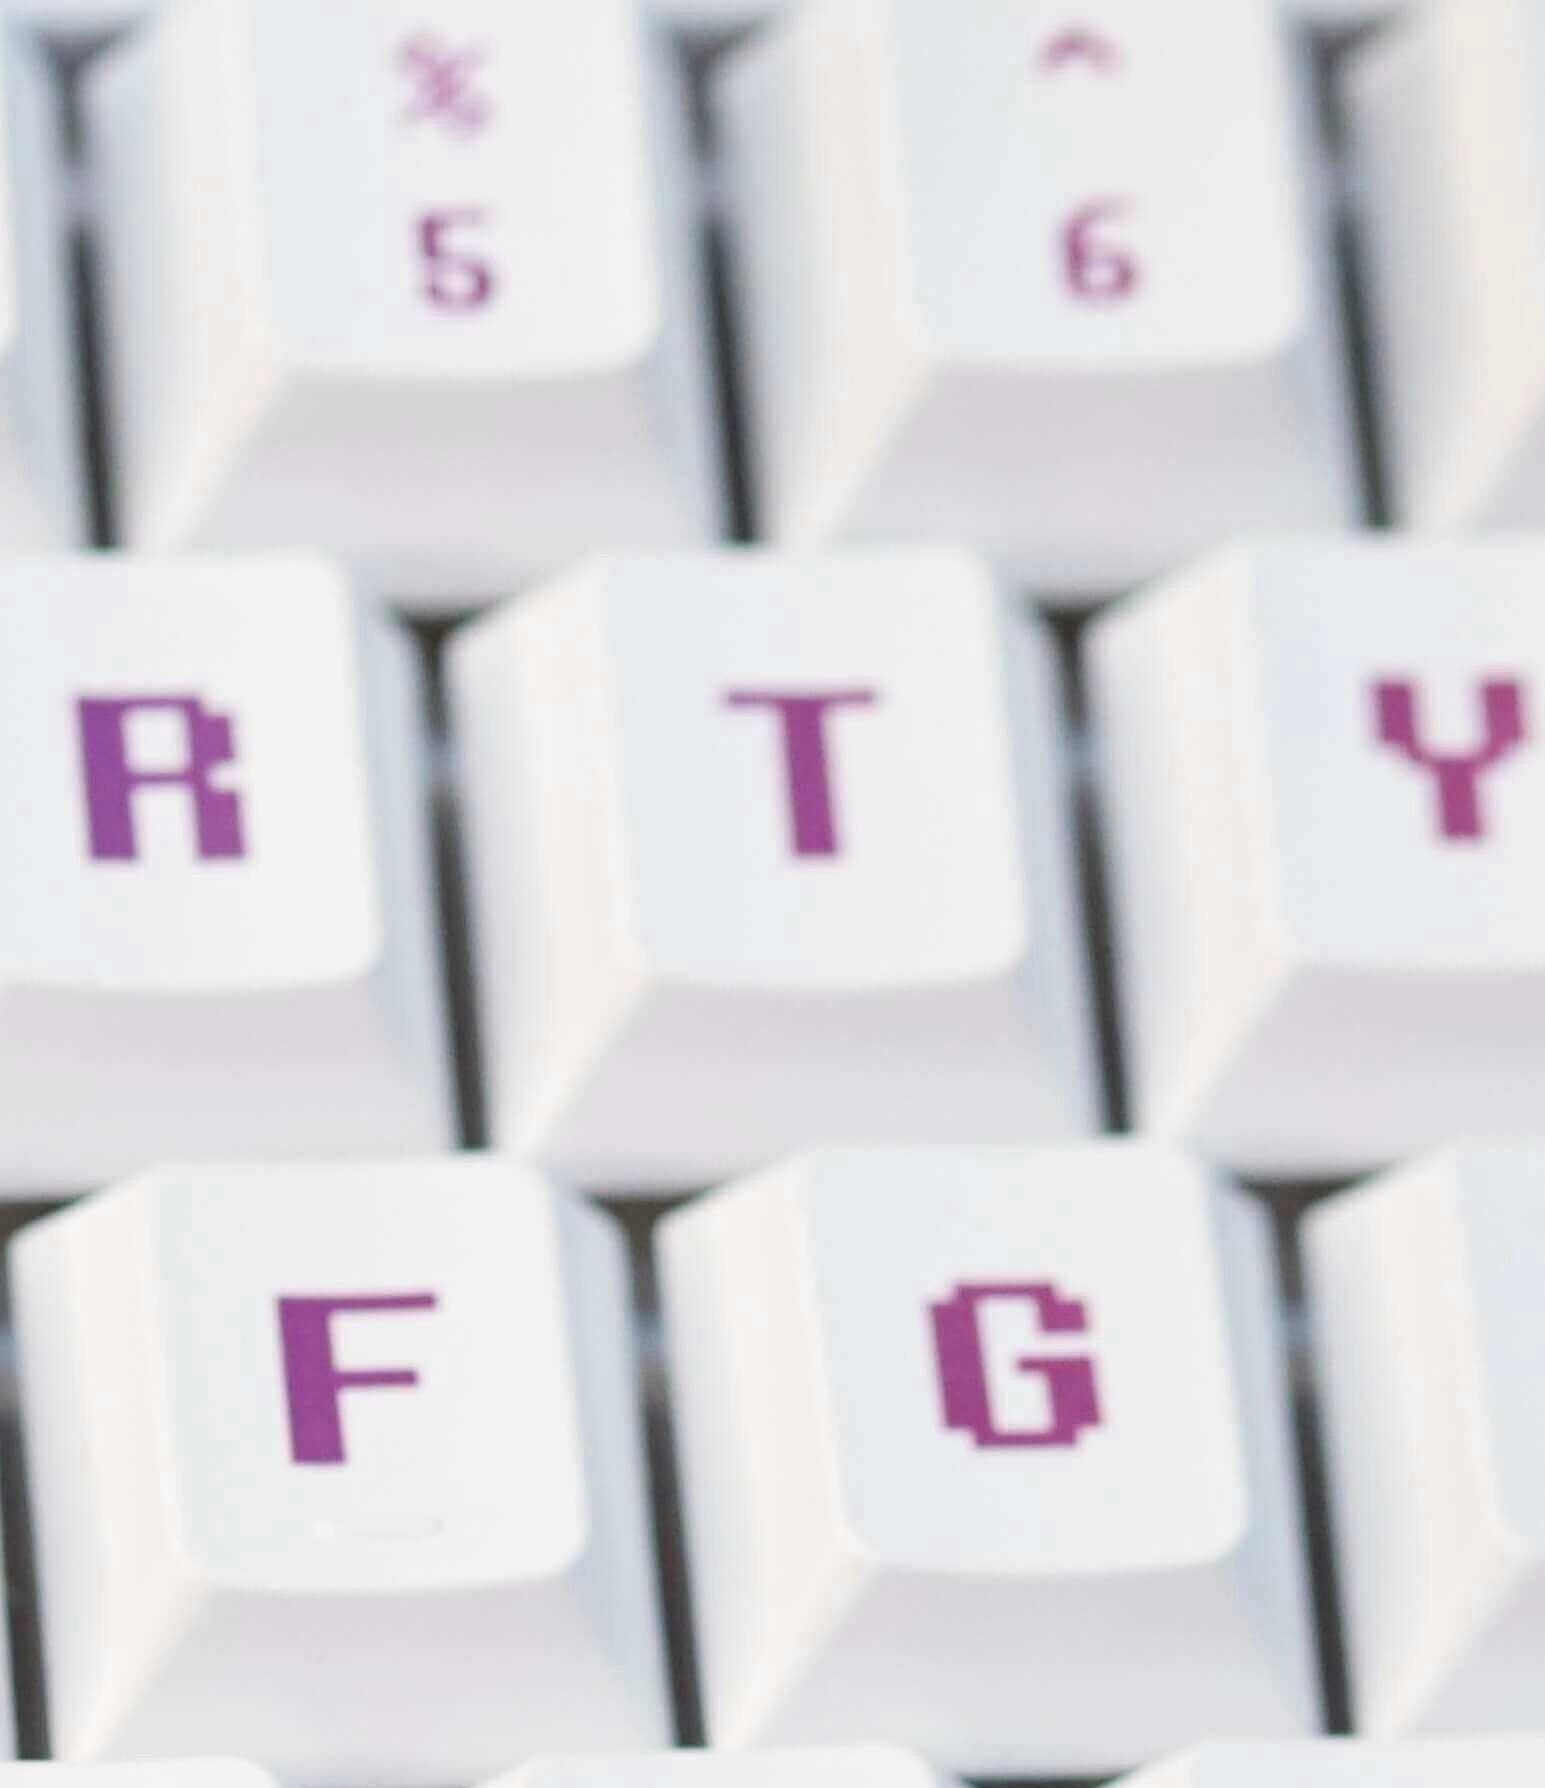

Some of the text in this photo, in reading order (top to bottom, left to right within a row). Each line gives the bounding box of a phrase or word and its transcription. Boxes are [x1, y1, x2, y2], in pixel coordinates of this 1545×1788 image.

[398, 36, 492, 136] %
[417, 213, 494, 308] 5
[1056, 202, 1140, 304] 6
[76, 697, 244, 859] R
[722, 690, 876, 858] T
[1367, 676, 1529, 843] Y
[276, 1290, 437, 1465] F
[930, 1282, 1100, 1446] G
